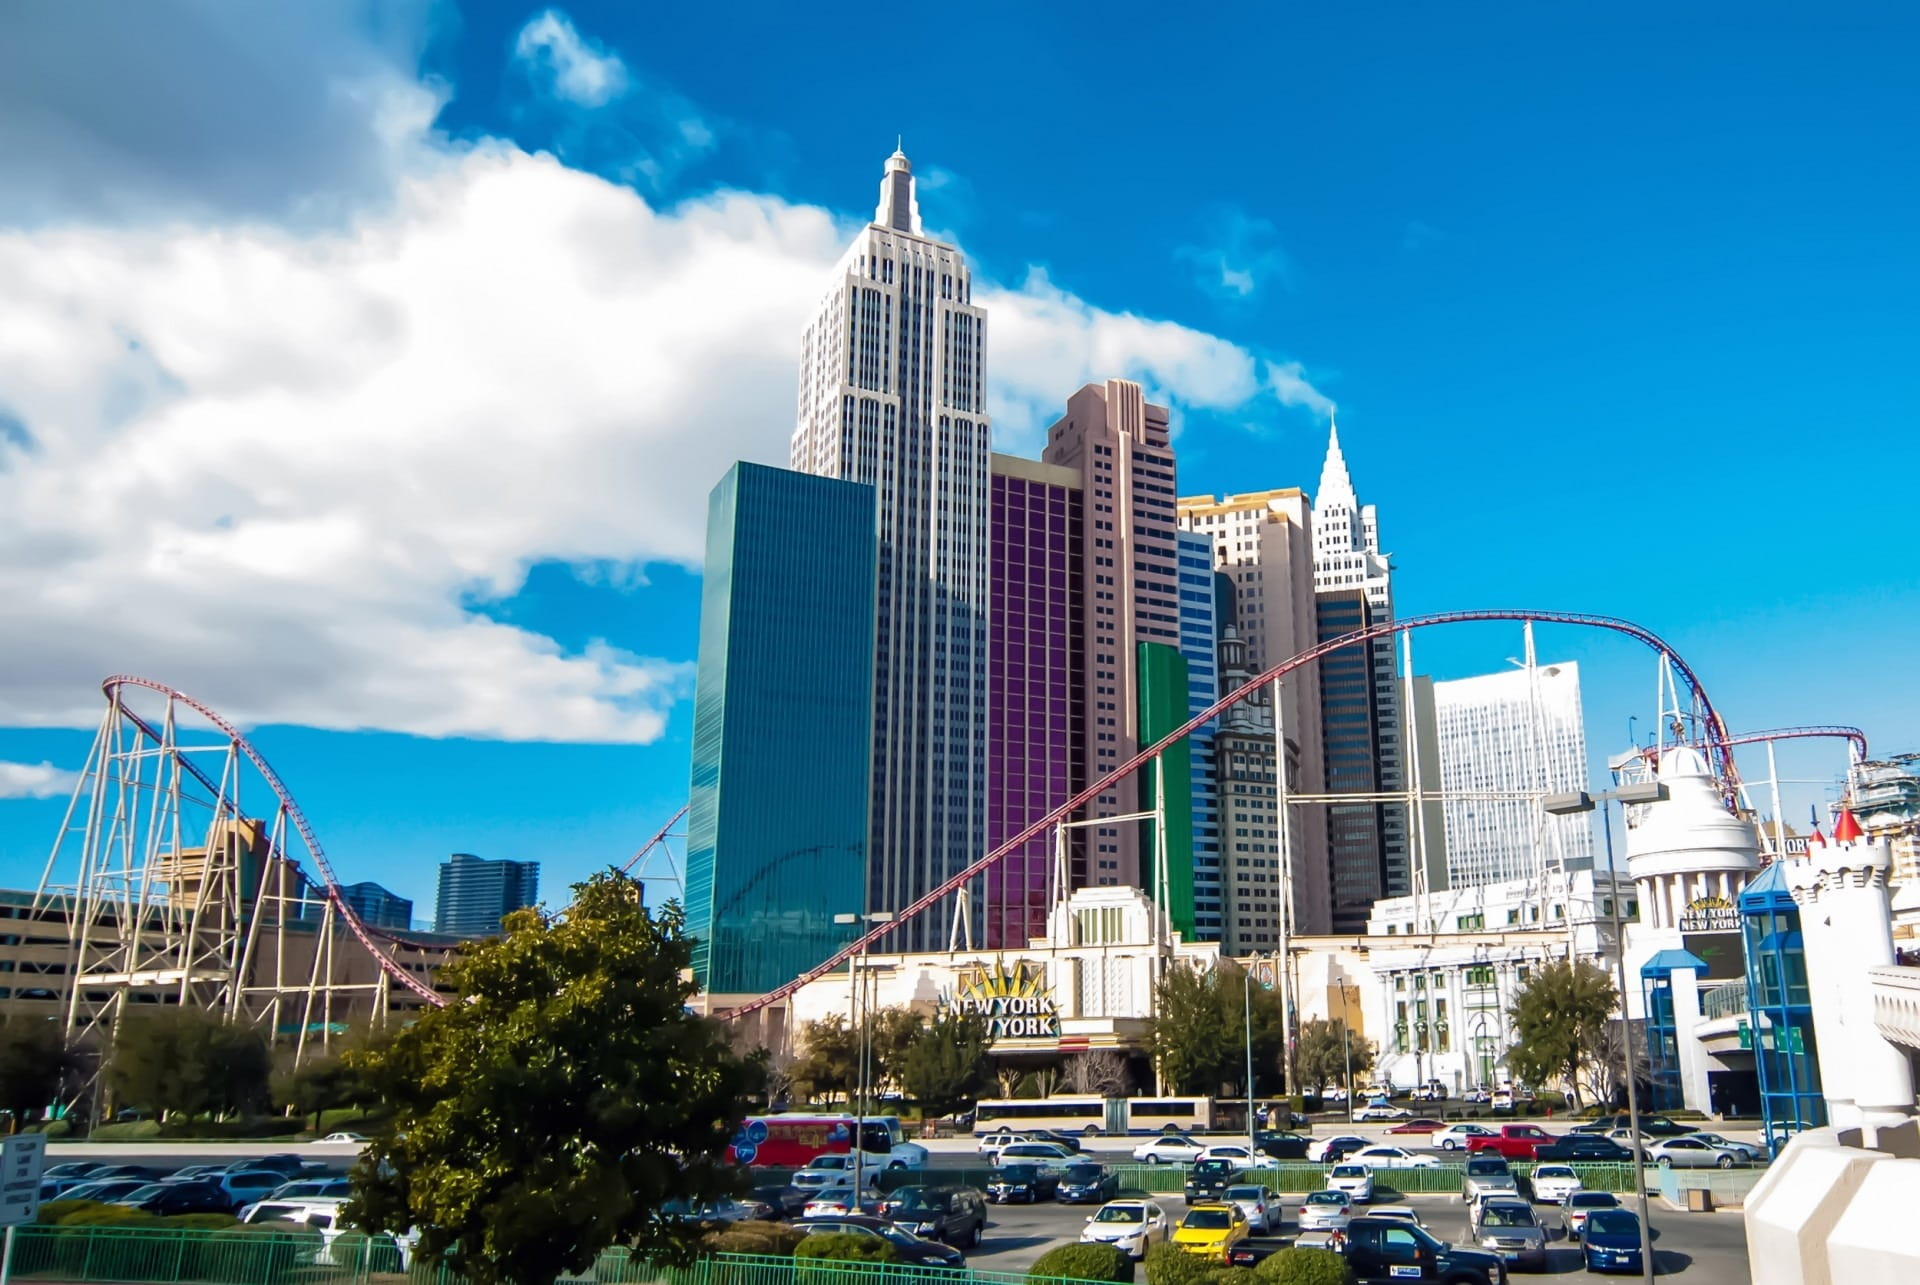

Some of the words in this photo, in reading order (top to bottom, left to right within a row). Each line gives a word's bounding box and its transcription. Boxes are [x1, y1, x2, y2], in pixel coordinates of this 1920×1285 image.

[1681, 919, 1707, 931] NEW
[950, 998, 994, 1016] NEW
[999, 997, 1054, 1014] YORK
[999, 1017, 1056, 1035] YORK
